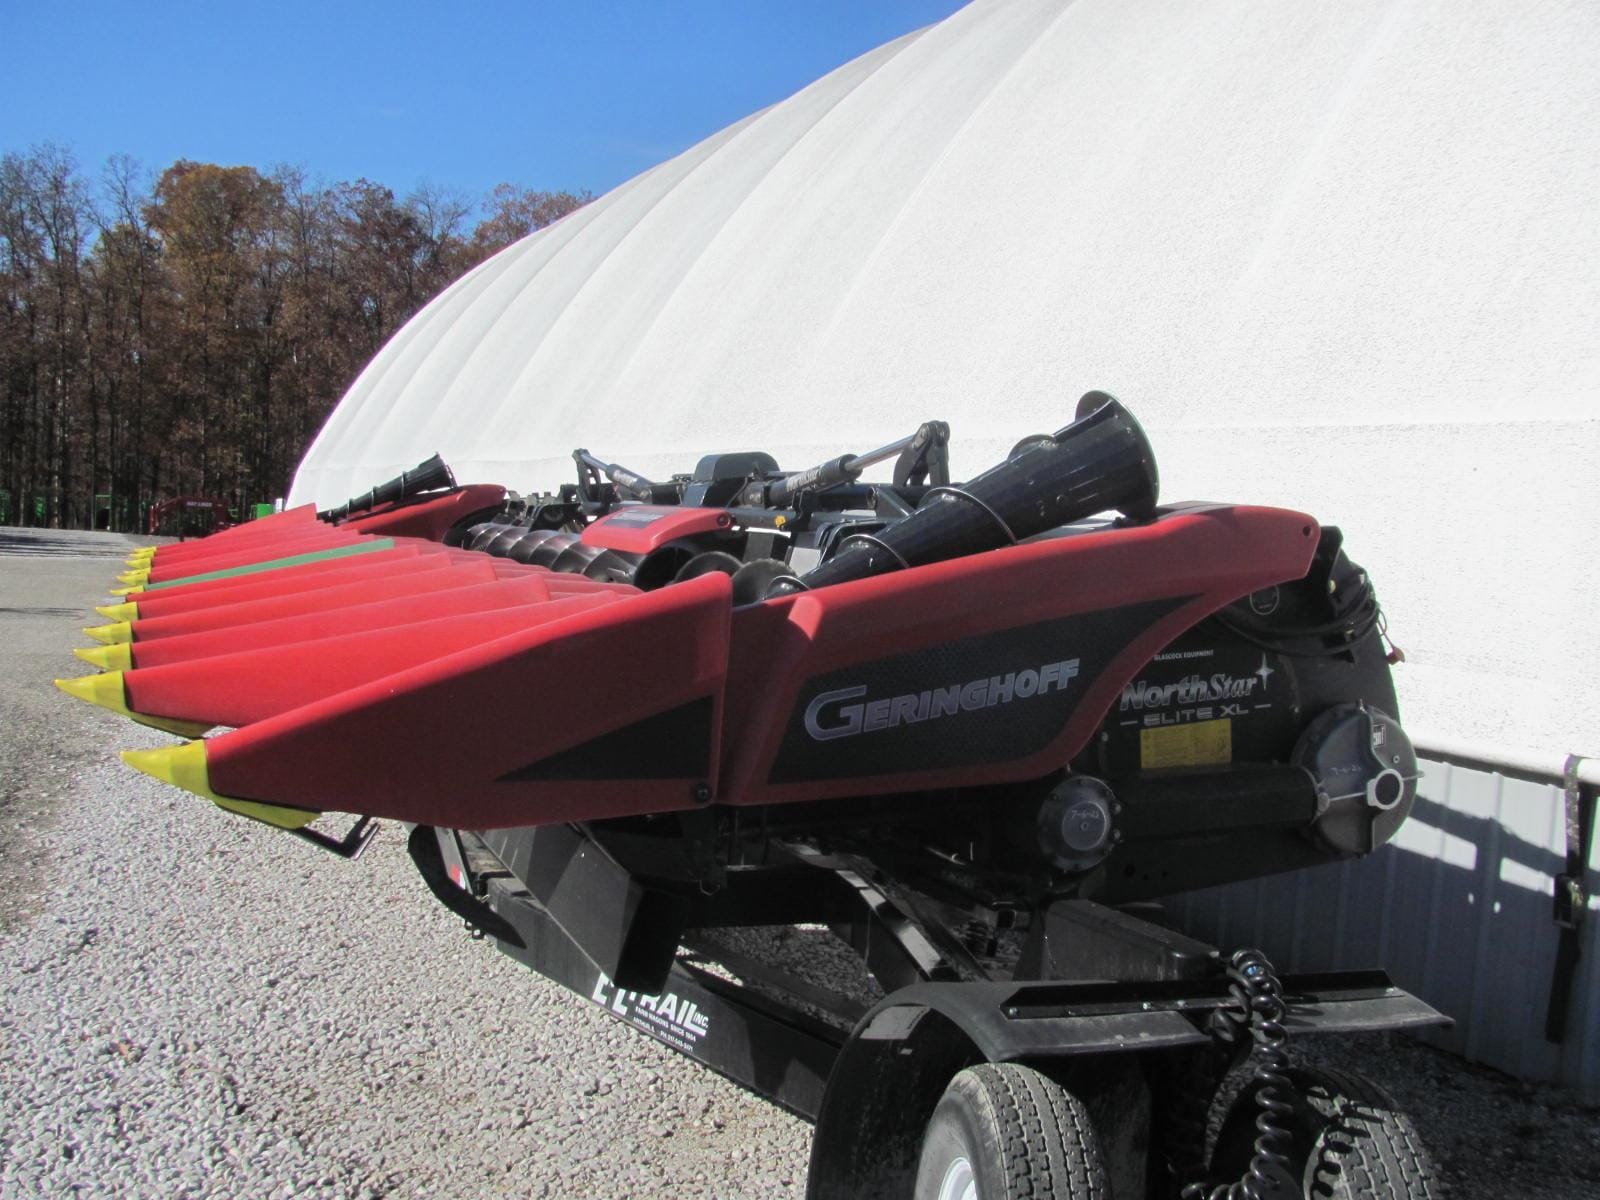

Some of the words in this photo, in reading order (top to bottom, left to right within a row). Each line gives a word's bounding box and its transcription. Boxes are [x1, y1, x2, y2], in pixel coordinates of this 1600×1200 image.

[1183, 649, 1214, 659] EQUIPMENT
[804, 658, 1080, 741] GERINGHOFF
[1143, 707, 1213, 726] ELITE
[1220, 703, 1249, 717] XL
